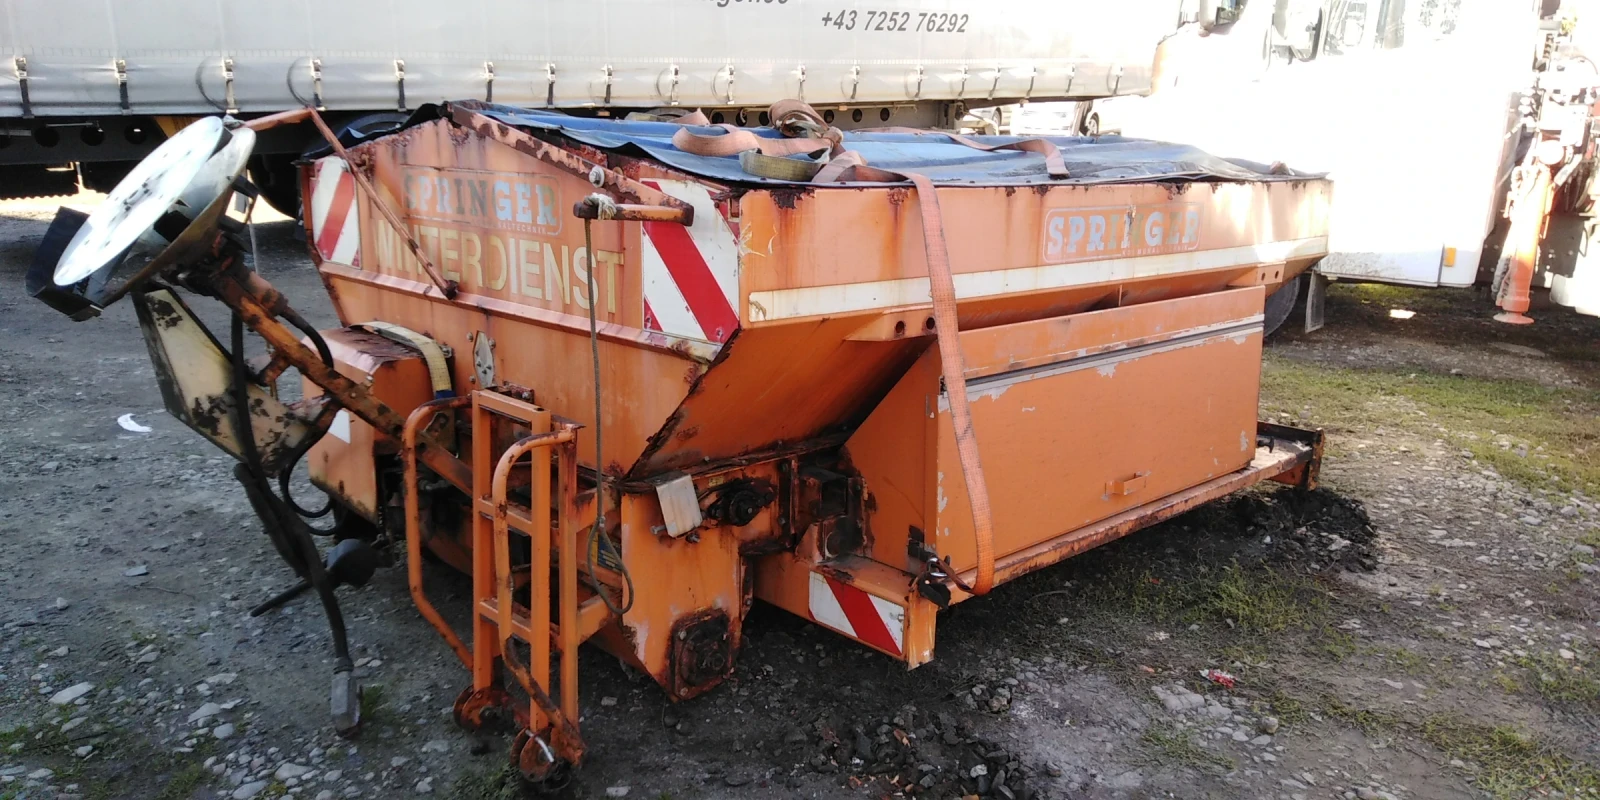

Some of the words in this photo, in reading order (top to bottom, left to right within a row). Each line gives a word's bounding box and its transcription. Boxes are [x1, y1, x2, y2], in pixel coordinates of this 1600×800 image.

[821, 10, 856, 30] +43
[863, 10, 910, 31] 7252
[915, 12, 969, 33] 76292
[404, 173, 557, 226] SPRINGER
[1047, 210, 1200, 256] SPRINGER
